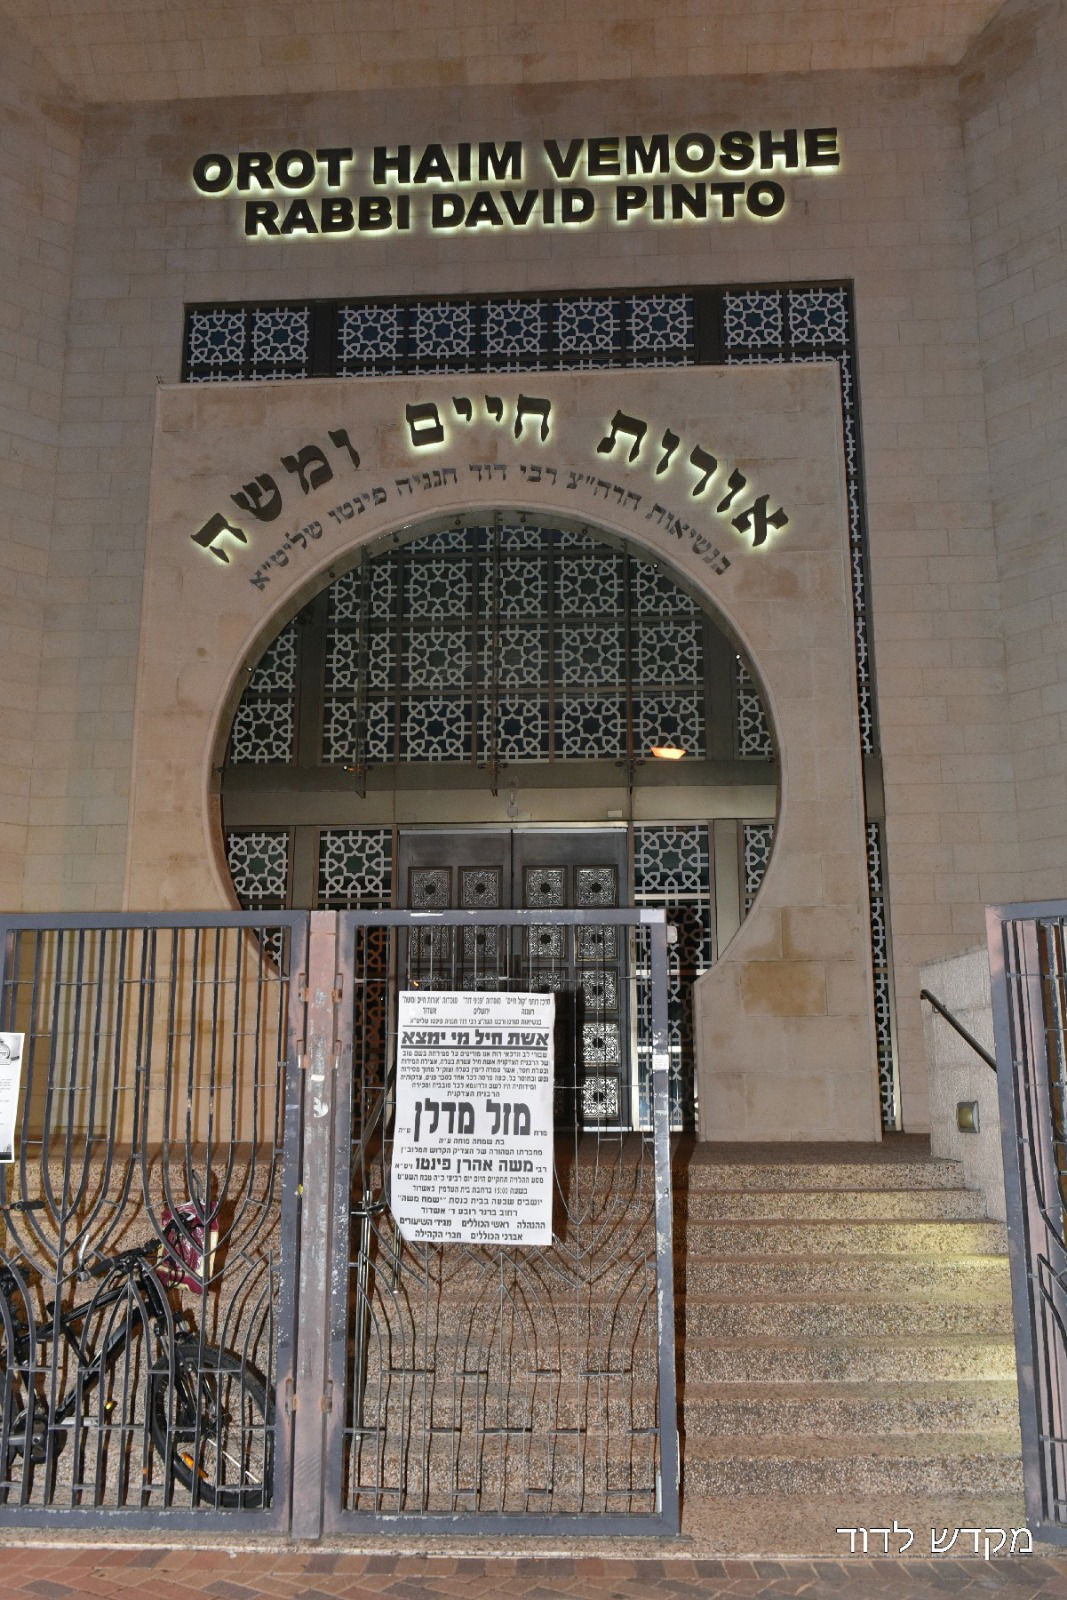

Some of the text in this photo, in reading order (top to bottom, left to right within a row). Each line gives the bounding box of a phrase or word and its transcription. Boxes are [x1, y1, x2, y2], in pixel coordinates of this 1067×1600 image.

[193, 127, 840, 193] OROT HAIM VEMOSHE
[245, 180, 785, 236] RABBI DAVID PINTO
[190, 394, 789, 564] אורות חיים ומשה
[394, 467, 458, 496] חנניה
[469, 463, 508, 482] דוד
[520, 464, 558, 486] רבי
[327, 486, 388, 525] פינטו
[645, 502, 732, 576] בנשיאות
[402, 1029, 550, 1046] אשת חיל מי ימצא
[414, 1098, 475, 1142] מדלן
[486, 1099, 531, 1136] מזל
[429, 1147, 451, 1155] הקדוש
[416, 1157, 451, 1170] פינטו
[457, 1158, 493, 1174] אהרן
[499, 1159, 533, 1172] משה
[400, 1217, 432, 1226] השיעורים
[462, 1218, 489, 1228] הכוללים
[517, 1220, 545, 1229] ההנהלה
[415, 1228, 443, 1240] הקהילה
[471, 1231, 499, 1240] הכוללים
